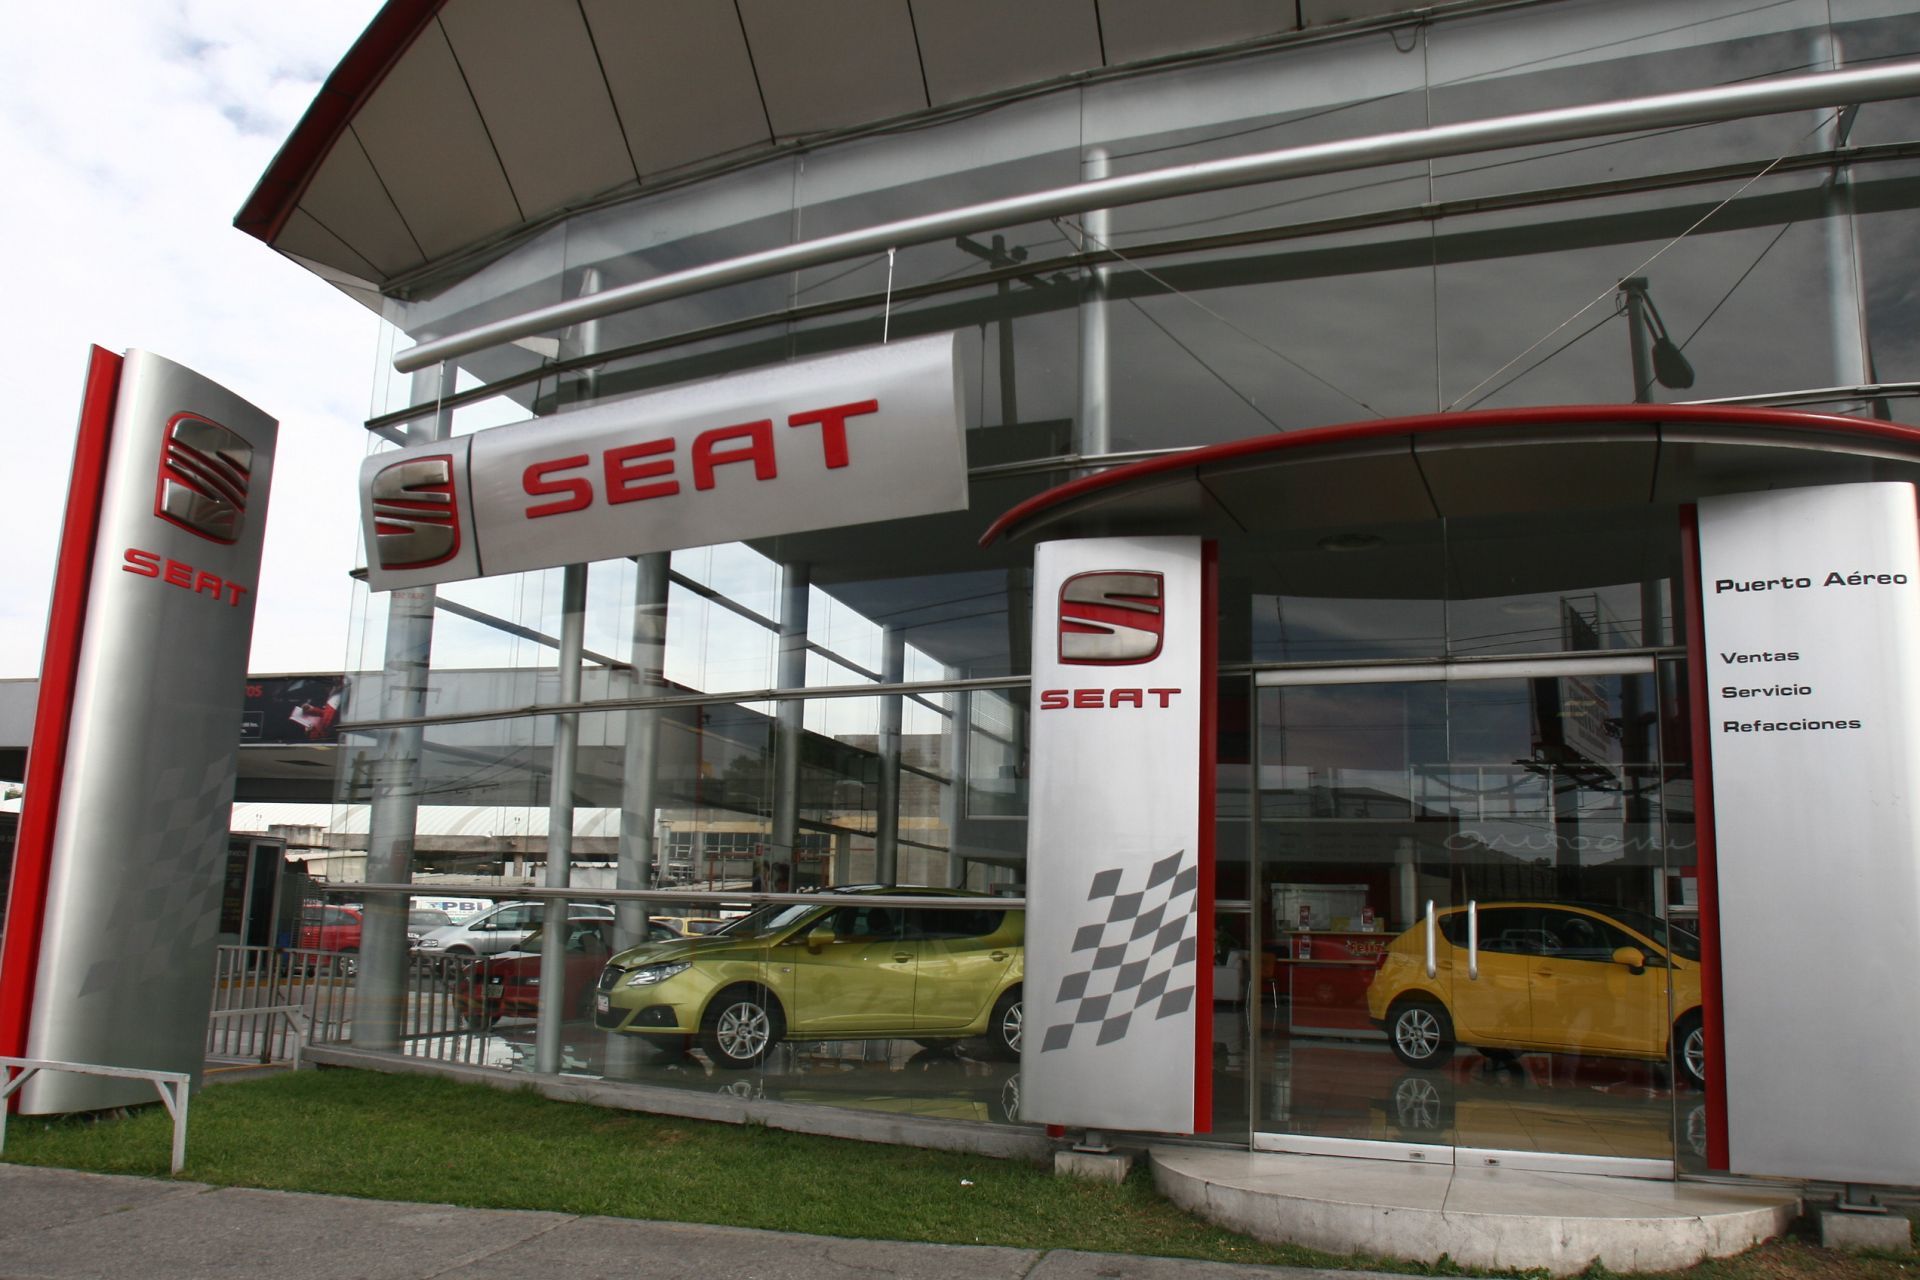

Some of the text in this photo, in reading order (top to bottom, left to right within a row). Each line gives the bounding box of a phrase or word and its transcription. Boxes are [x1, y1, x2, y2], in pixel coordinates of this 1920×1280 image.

[522, 398, 879, 519] SEAT
[122, 548, 247, 607] SEAT
[1715, 571, 1908, 594] Puerto Aéreo
[1720, 651, 1800, 665] Ventas
[1040, 688, 1182, 710] SEAT
[1722, 684, 1812, 699] Servicio
[1723, 718, 1862, 733] Refacciones
